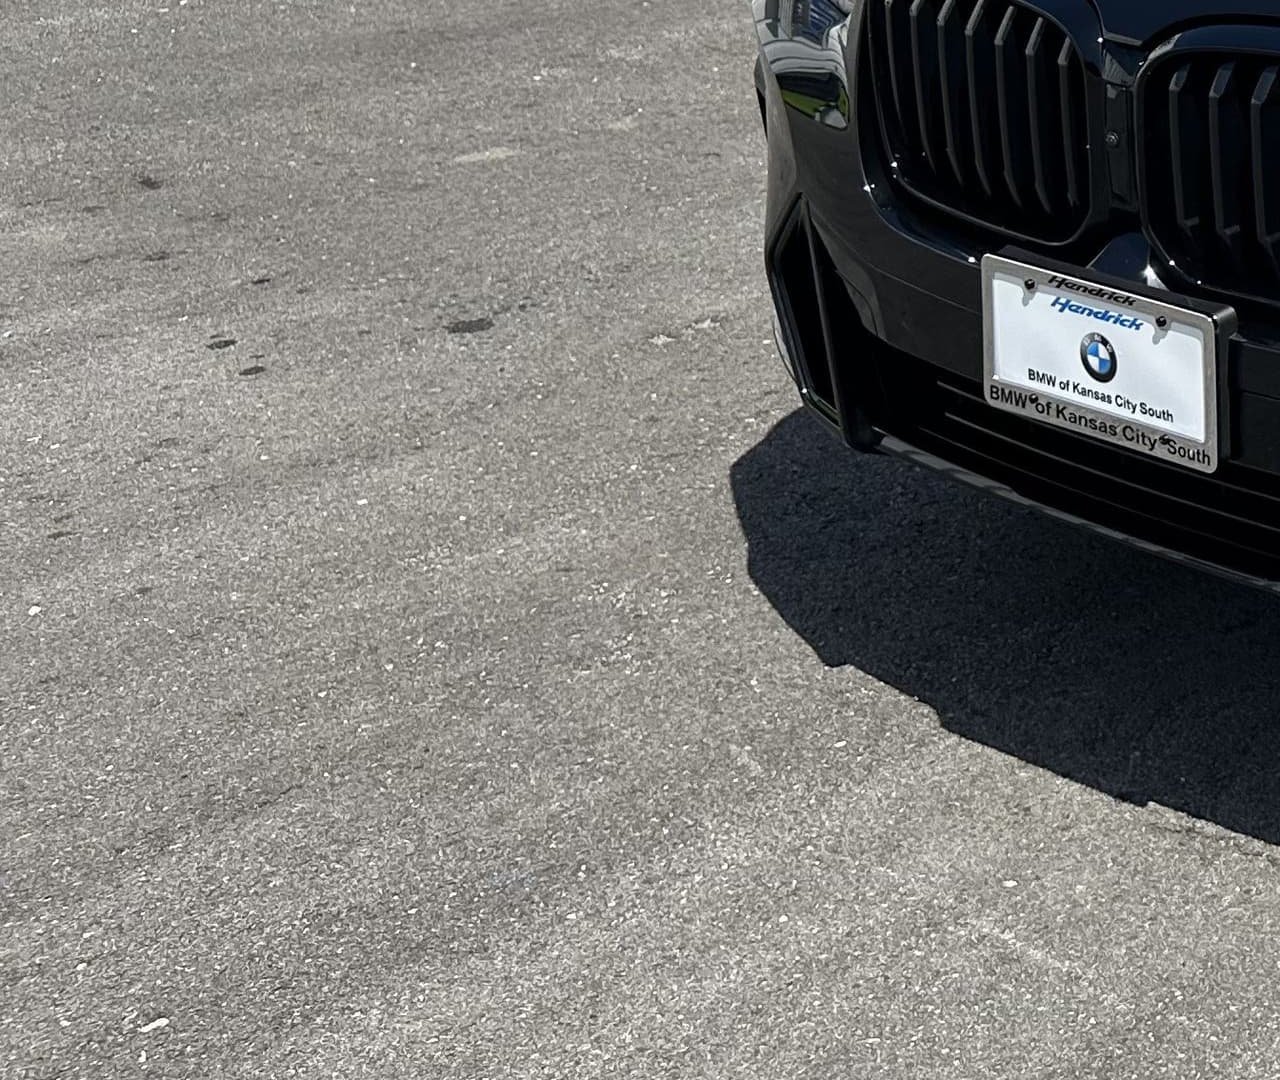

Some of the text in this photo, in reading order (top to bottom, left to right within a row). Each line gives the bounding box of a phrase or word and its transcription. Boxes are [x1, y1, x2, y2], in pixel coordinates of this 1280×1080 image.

[1048, 275, 1136, 306] Hendrick
[1050, 296, 1144, 331] Hendrick
[1028, 368, 1174, 422] BMW of Kansas City South
[990, 385, 1211, 466] BMW of Kansas City South
